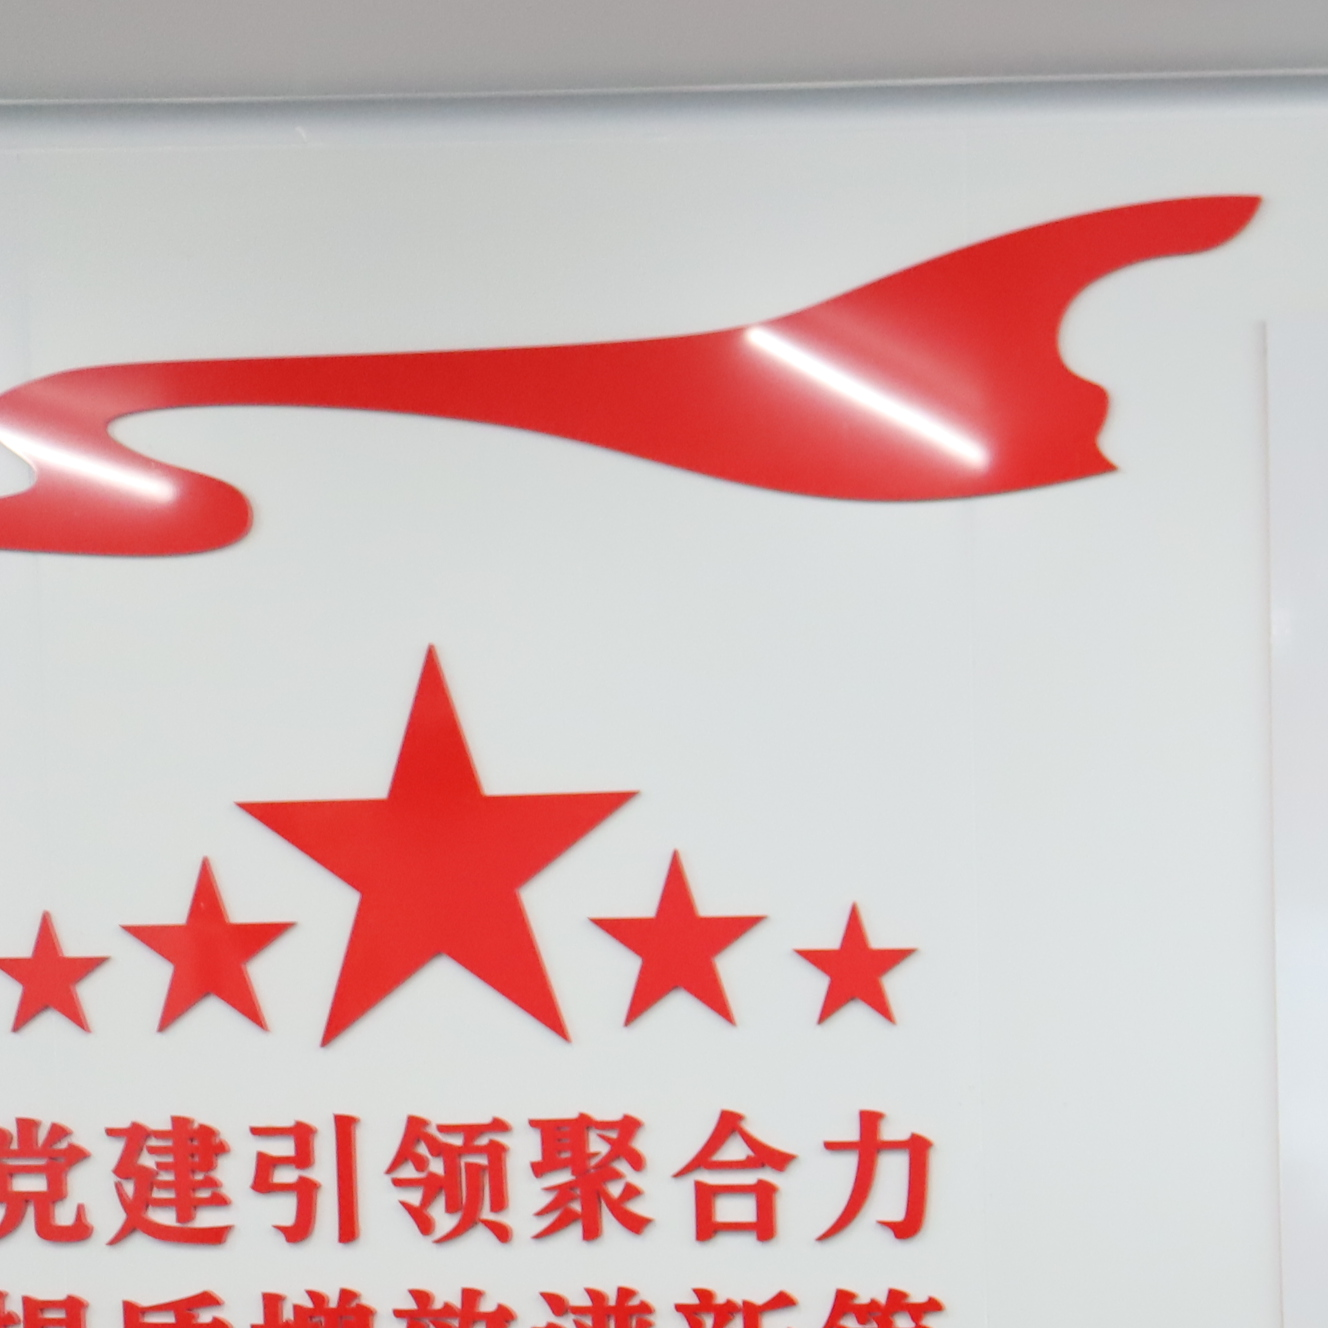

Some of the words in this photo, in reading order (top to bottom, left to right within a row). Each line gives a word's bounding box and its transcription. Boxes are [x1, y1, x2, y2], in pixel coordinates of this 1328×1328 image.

[0, 1108, 935, 1248] 党建引领聚合力
